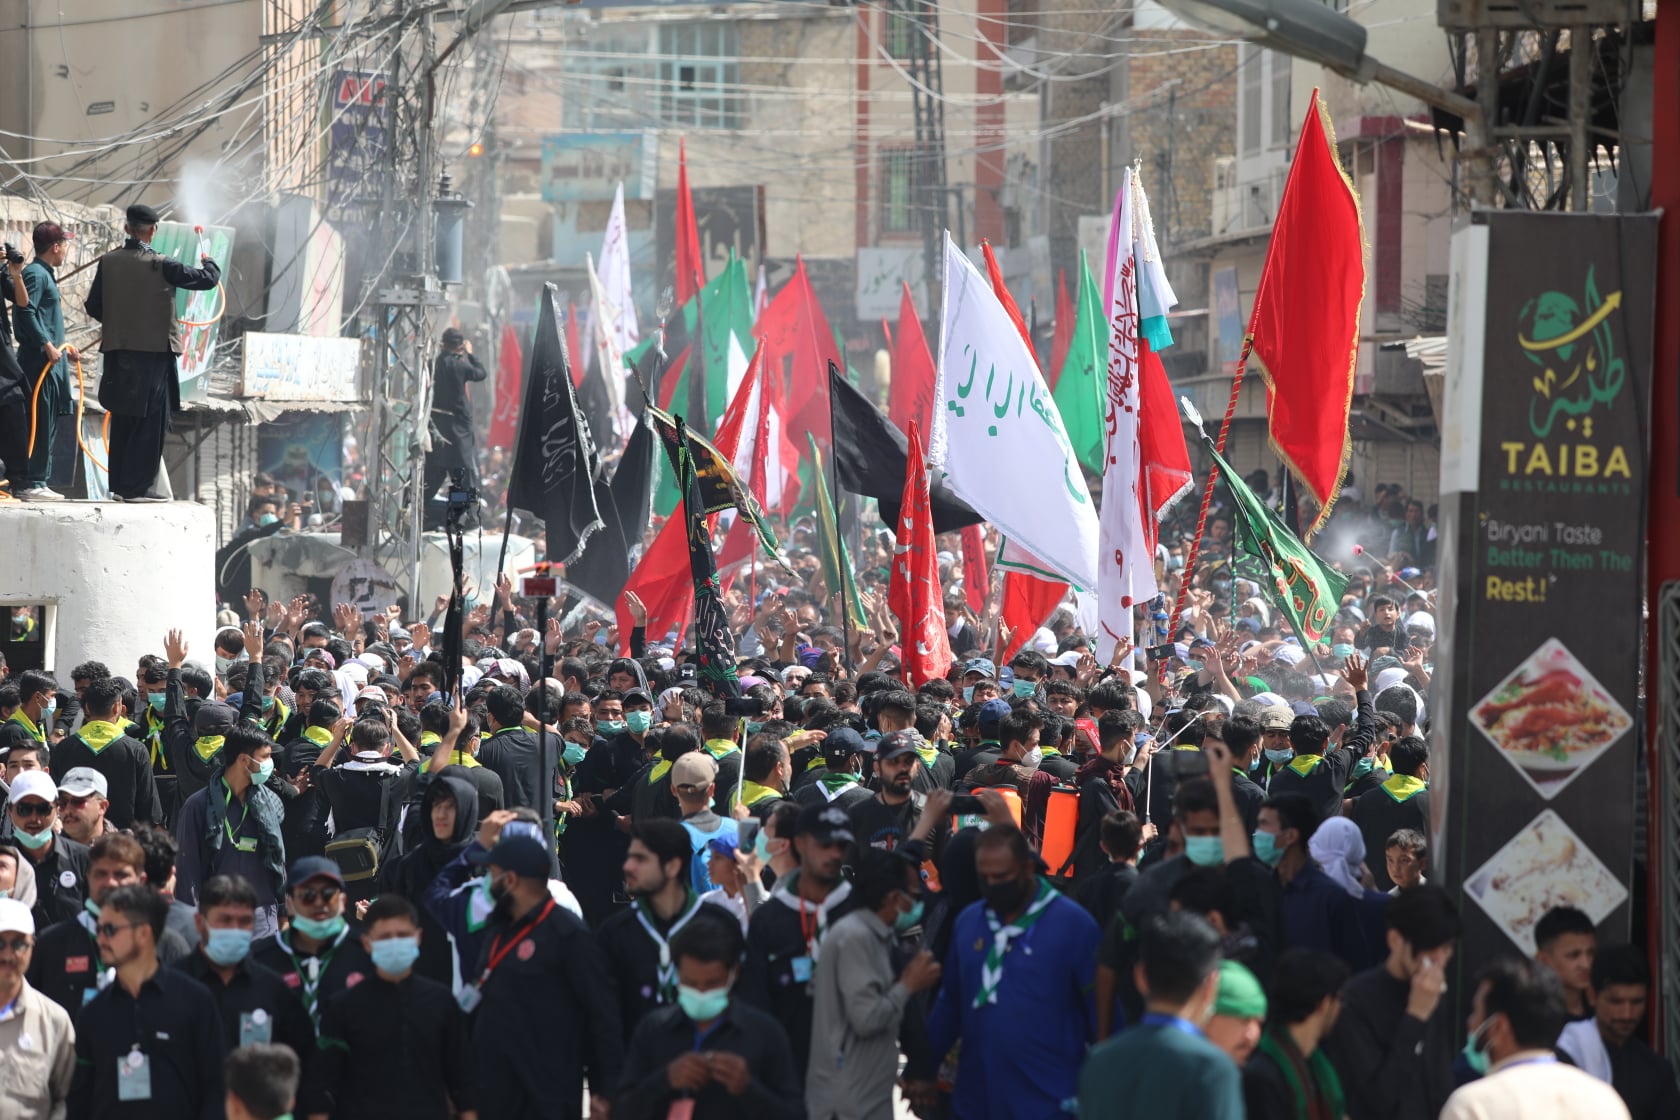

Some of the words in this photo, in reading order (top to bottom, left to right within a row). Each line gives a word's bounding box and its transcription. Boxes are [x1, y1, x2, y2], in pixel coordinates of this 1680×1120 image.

[1500, 442, 1631, 478] TAIBA
[1554, 522, 1603, 545] Taste
[1487, 546, 1544, 568] Better
[1549, 548, 1595, 570] Then
[1600, 550, 1632, 572] The
